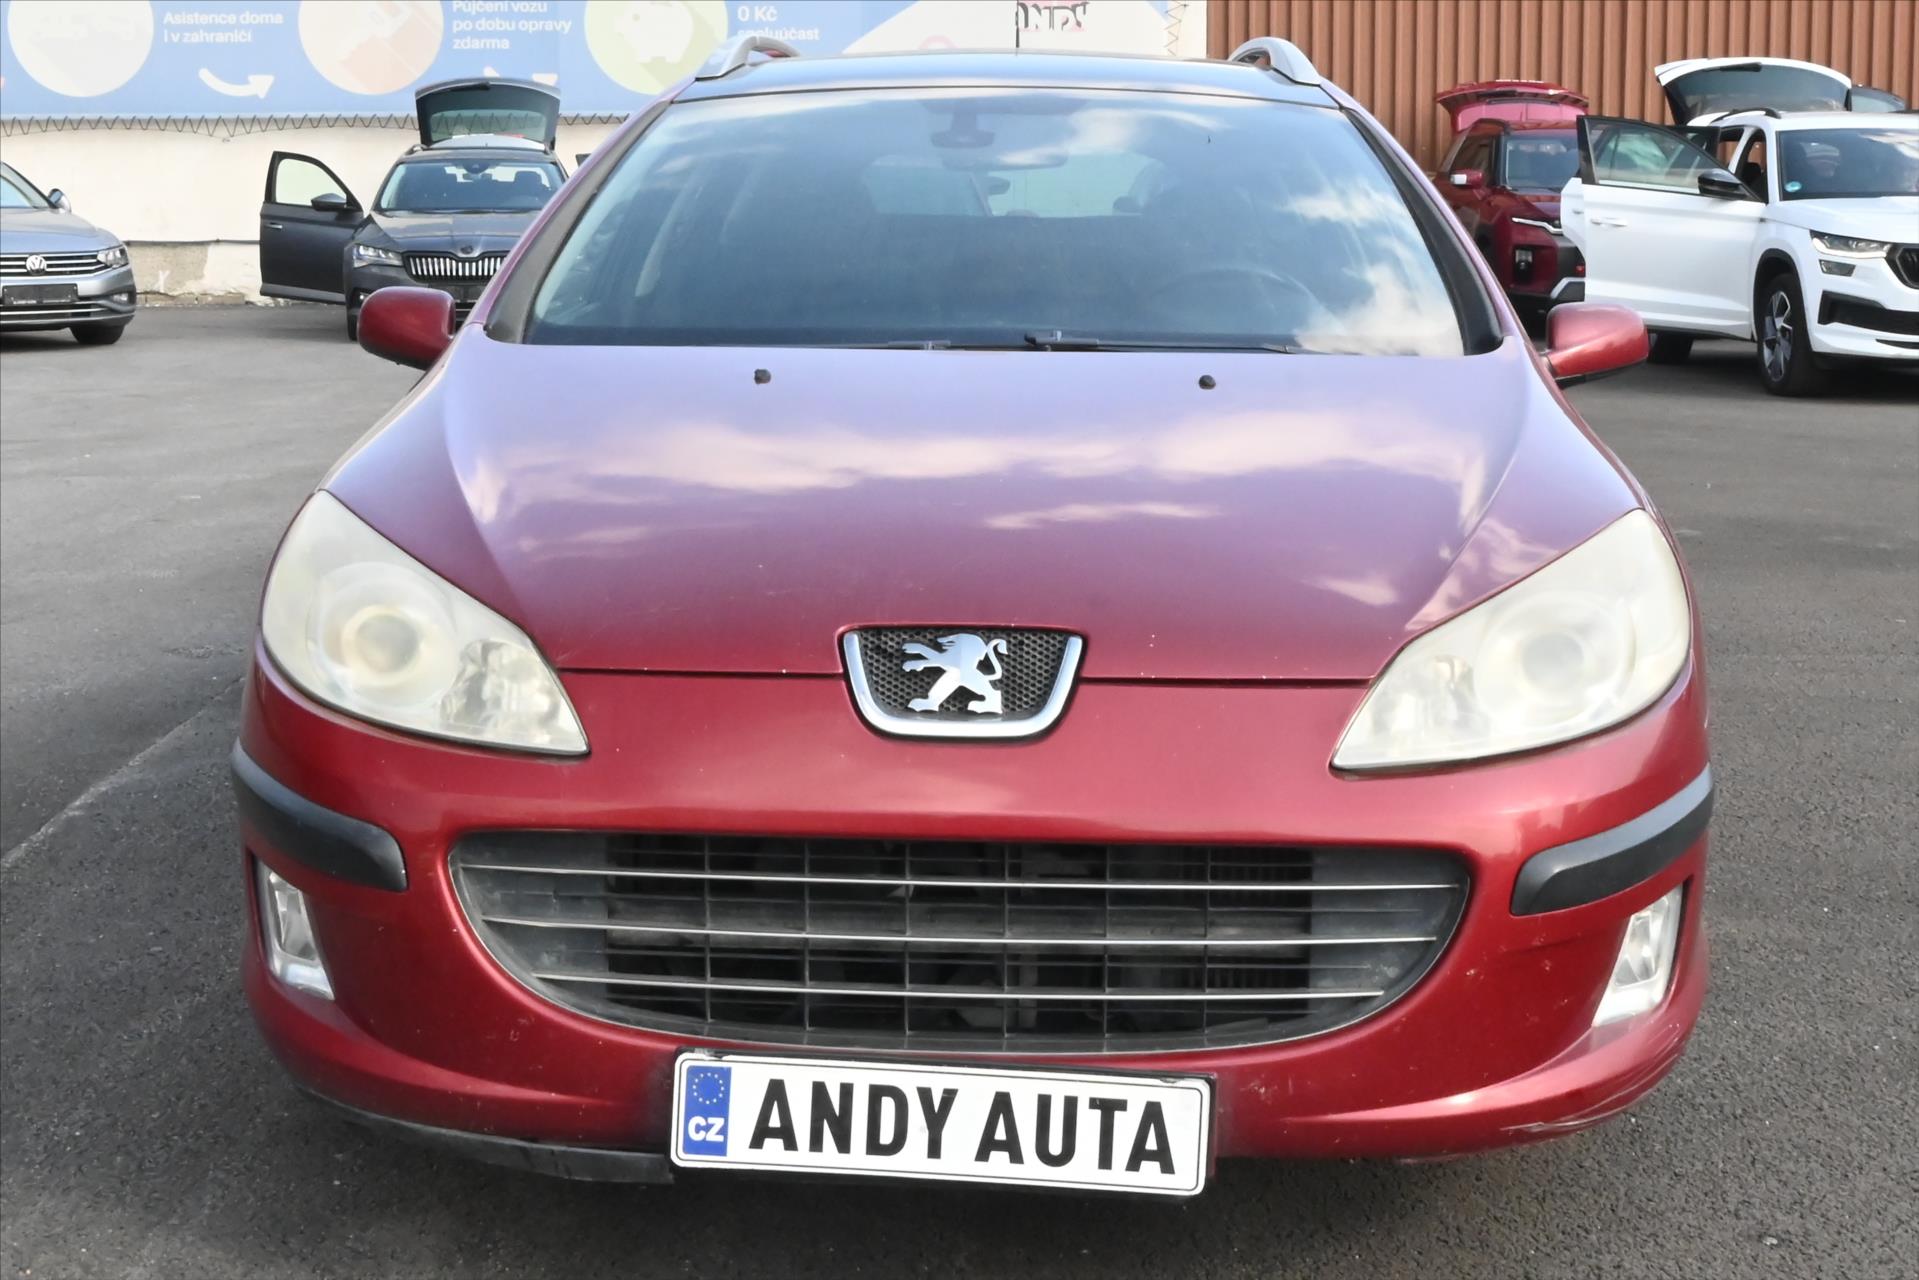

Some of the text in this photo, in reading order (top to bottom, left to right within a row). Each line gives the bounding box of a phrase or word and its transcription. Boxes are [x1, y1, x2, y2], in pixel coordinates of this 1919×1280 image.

[511, 2, 548, 13] vozu
[737, 6, 778, 22] 0 Kč
[164, 11, 284, 25] Asistence doma
[453, 18, 572, 34] po dobu opravy
[171, 32, 180, 43] v
[182, 29, 252, 43] zahraničí
[453, 36, 510, 49] zdarma
[688, 1115, 725, 1142] CZ
[748, 1078, 1176, 1175] ANDY AUTA
